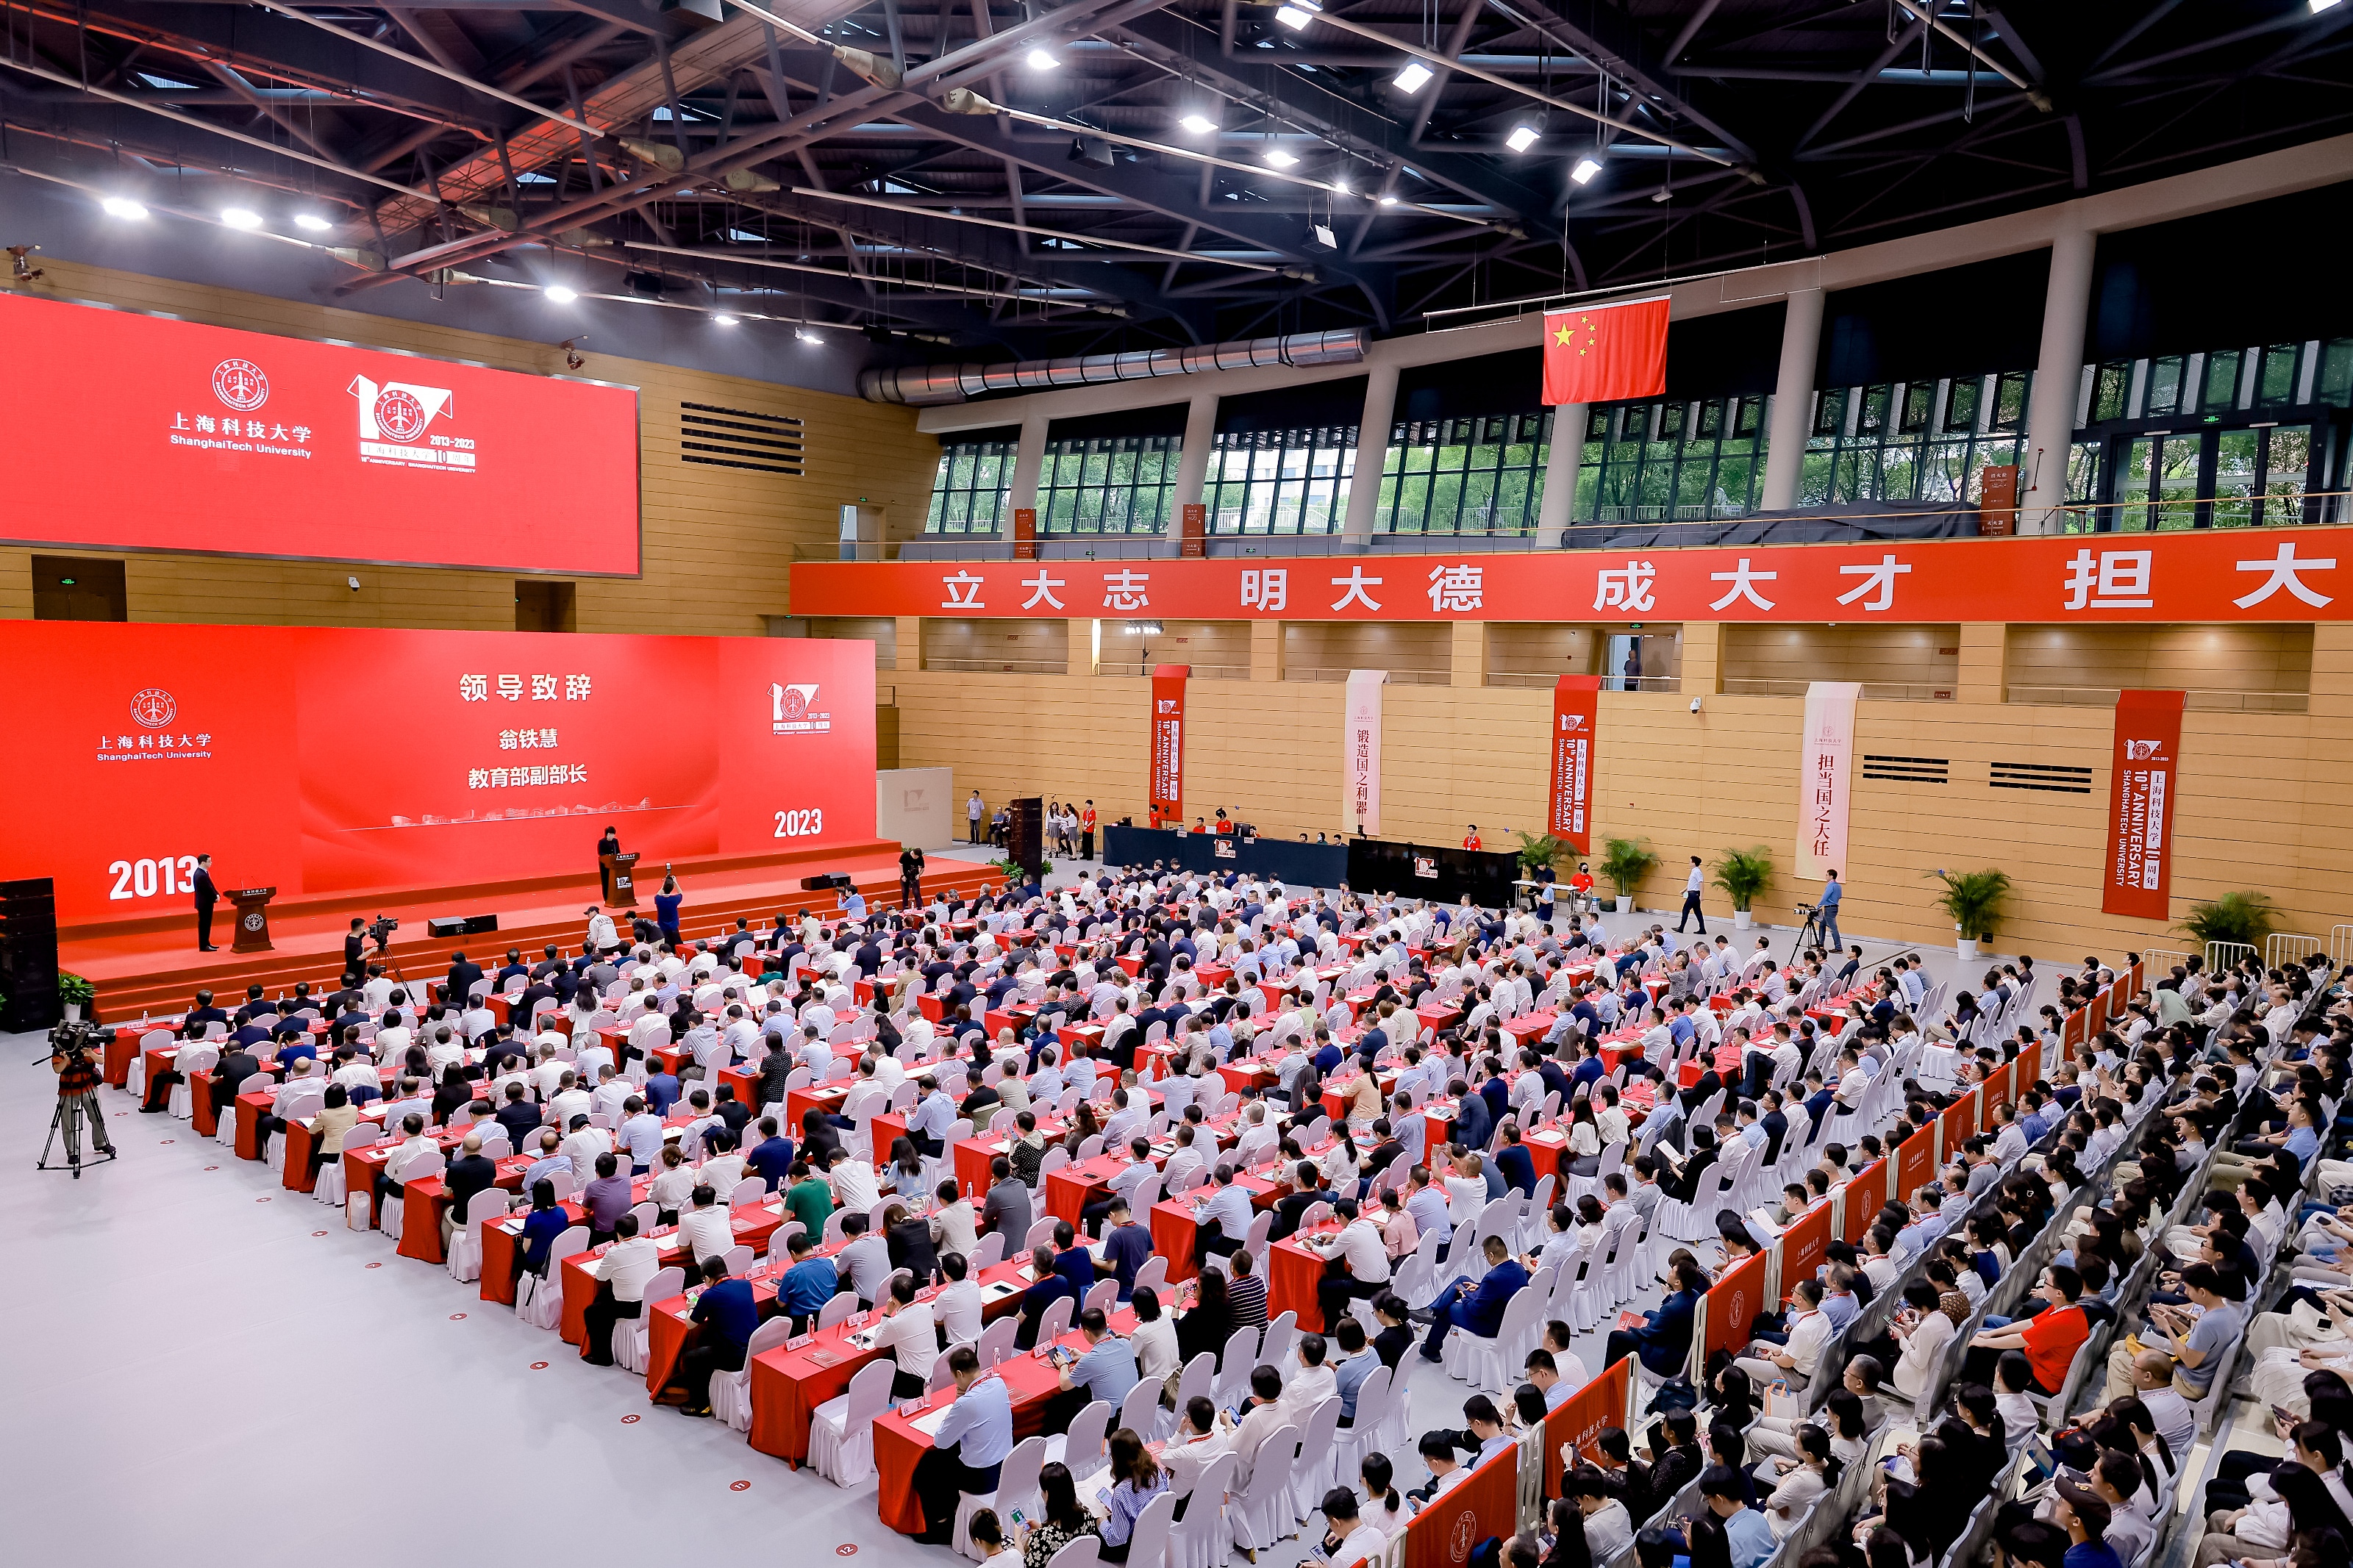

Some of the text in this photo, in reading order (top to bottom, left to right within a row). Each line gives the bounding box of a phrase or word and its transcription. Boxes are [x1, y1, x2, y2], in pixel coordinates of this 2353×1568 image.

[169, 412, 312, 443] 上海科技大学
[429, 434, 475, 450] 2013-2023
[170, 434, 312, 459] ShanghaiTech University
[407, 462, 447, 470] SHANGHAITECH
[941, 543, 2337, 612] 立大志 明大德 成大才 担大
[459, 673, 592, 701] 领导致辞
[96, 733, 212, 750] 上海科技大学
[498, 728, 558, 751] 翁铁慧
[97, 751, 212, 762] ShanghaiTech University
[1162, 735, 1170, 801] ANNIVERSARY
[1355, 728, 1370, 815] 锻造国之利器
[468, 763, 588, 790] 教育部副部长
[1554, 738, 1565, 831] SHANGHAITECH UNIVERSITY
[1562, 756, 1574, 832] ANNIVERSARY
[1813, 753, 1835, 857] 担当国之大任
[774, 808, 823, 839] 2023
[2115, 770, 2132, 887] SHANGHAITECH UNIVERSITY
[2127, 770, 2149, 889] 10th ANNIVERSARY
[108, 854, 199, 901] 2013
[840, 1546, 854, 1555] 12
